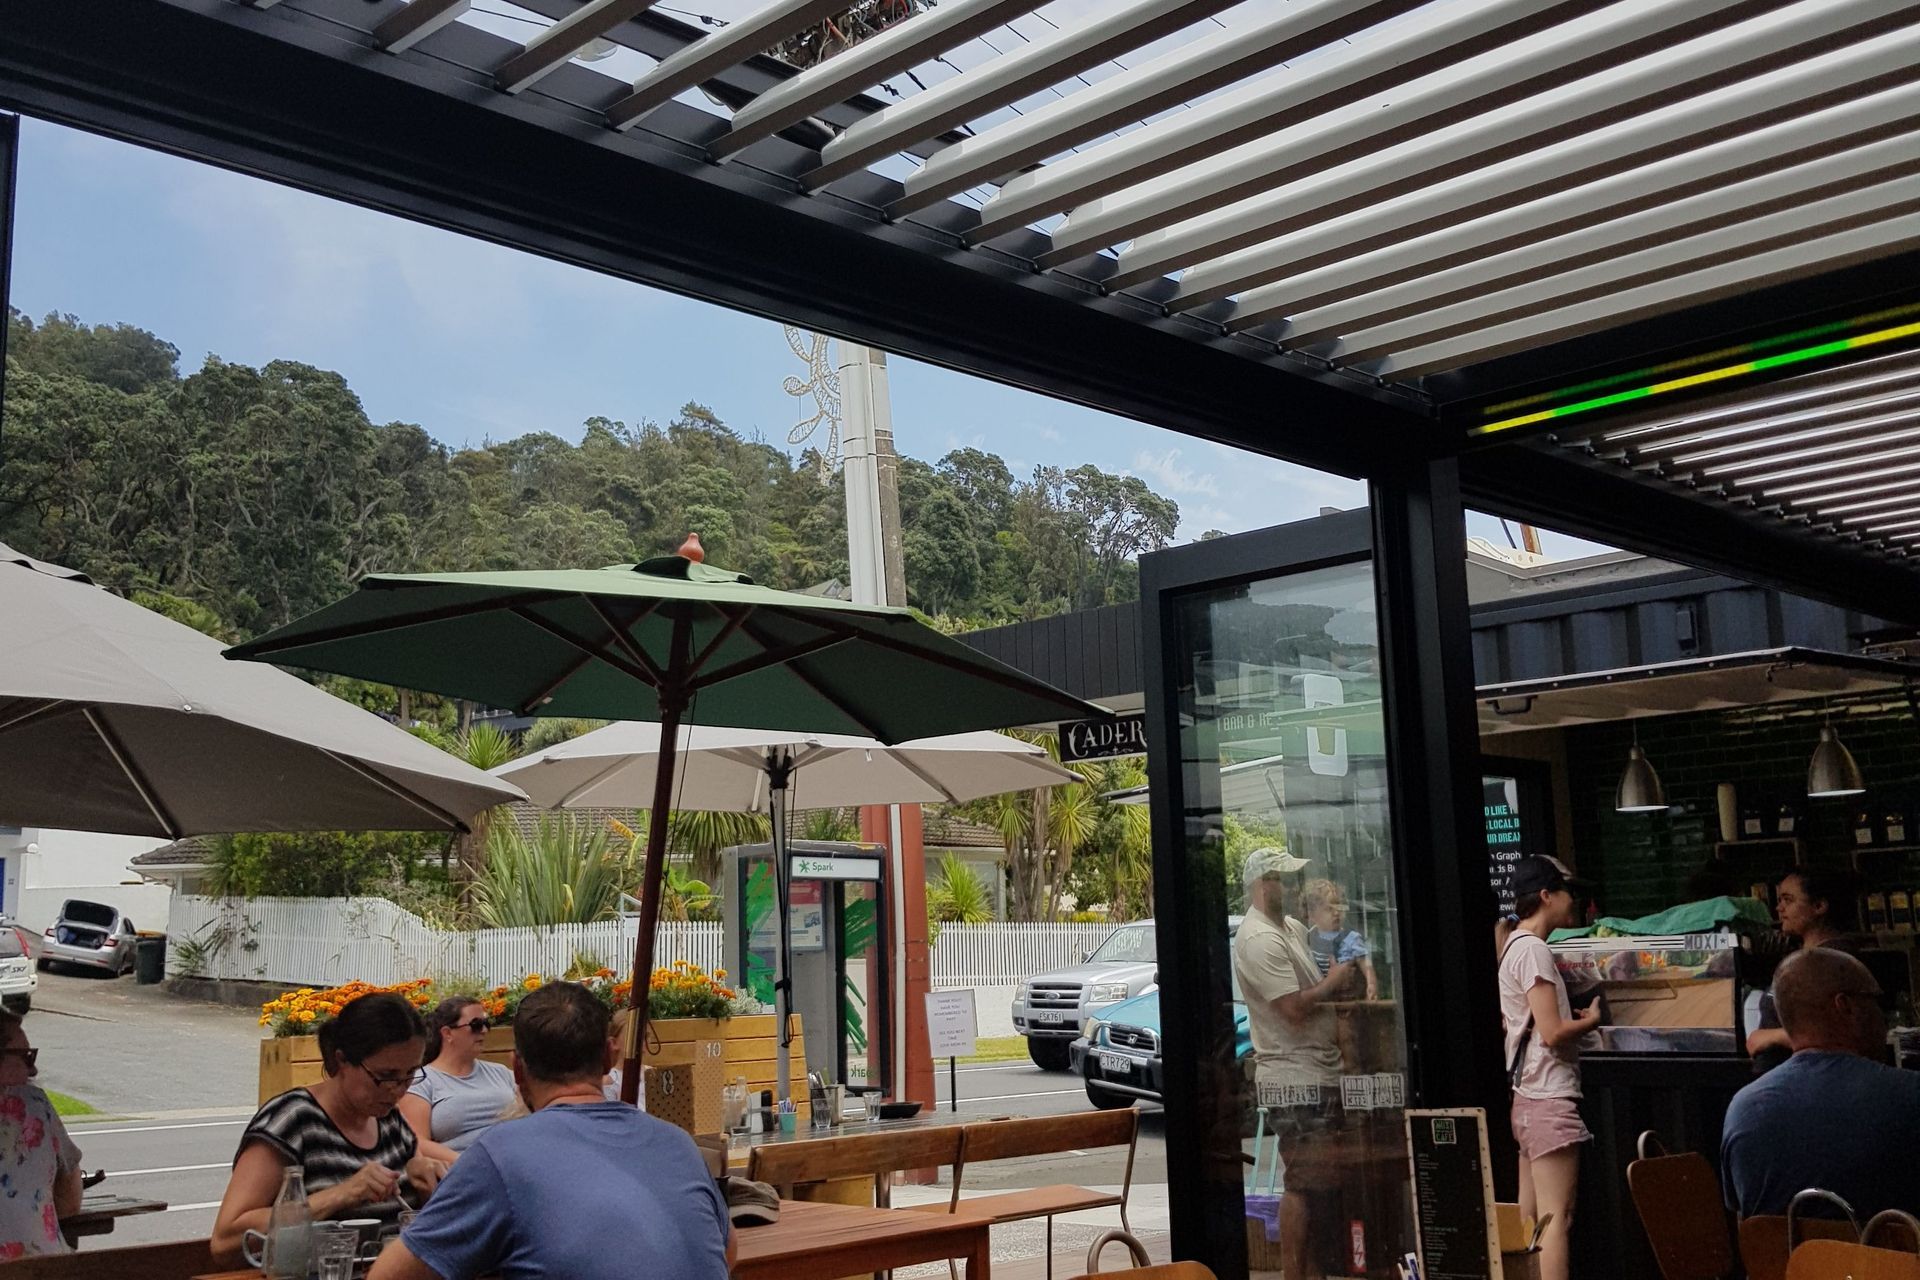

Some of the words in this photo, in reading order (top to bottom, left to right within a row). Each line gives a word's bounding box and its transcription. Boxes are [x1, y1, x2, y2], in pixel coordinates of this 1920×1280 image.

[1223, 715, 1243, 731] BAR
[1490, 804, 1508, 816] LIKE
[1488, 818, 1513, 830] LOCAL
[812, 861, 834, 872] Spark
[1684, 934, 1718, 950] MOXI
[706, 1041, 721, 1058] 10
[662, 1070, 675, 1096] 8
